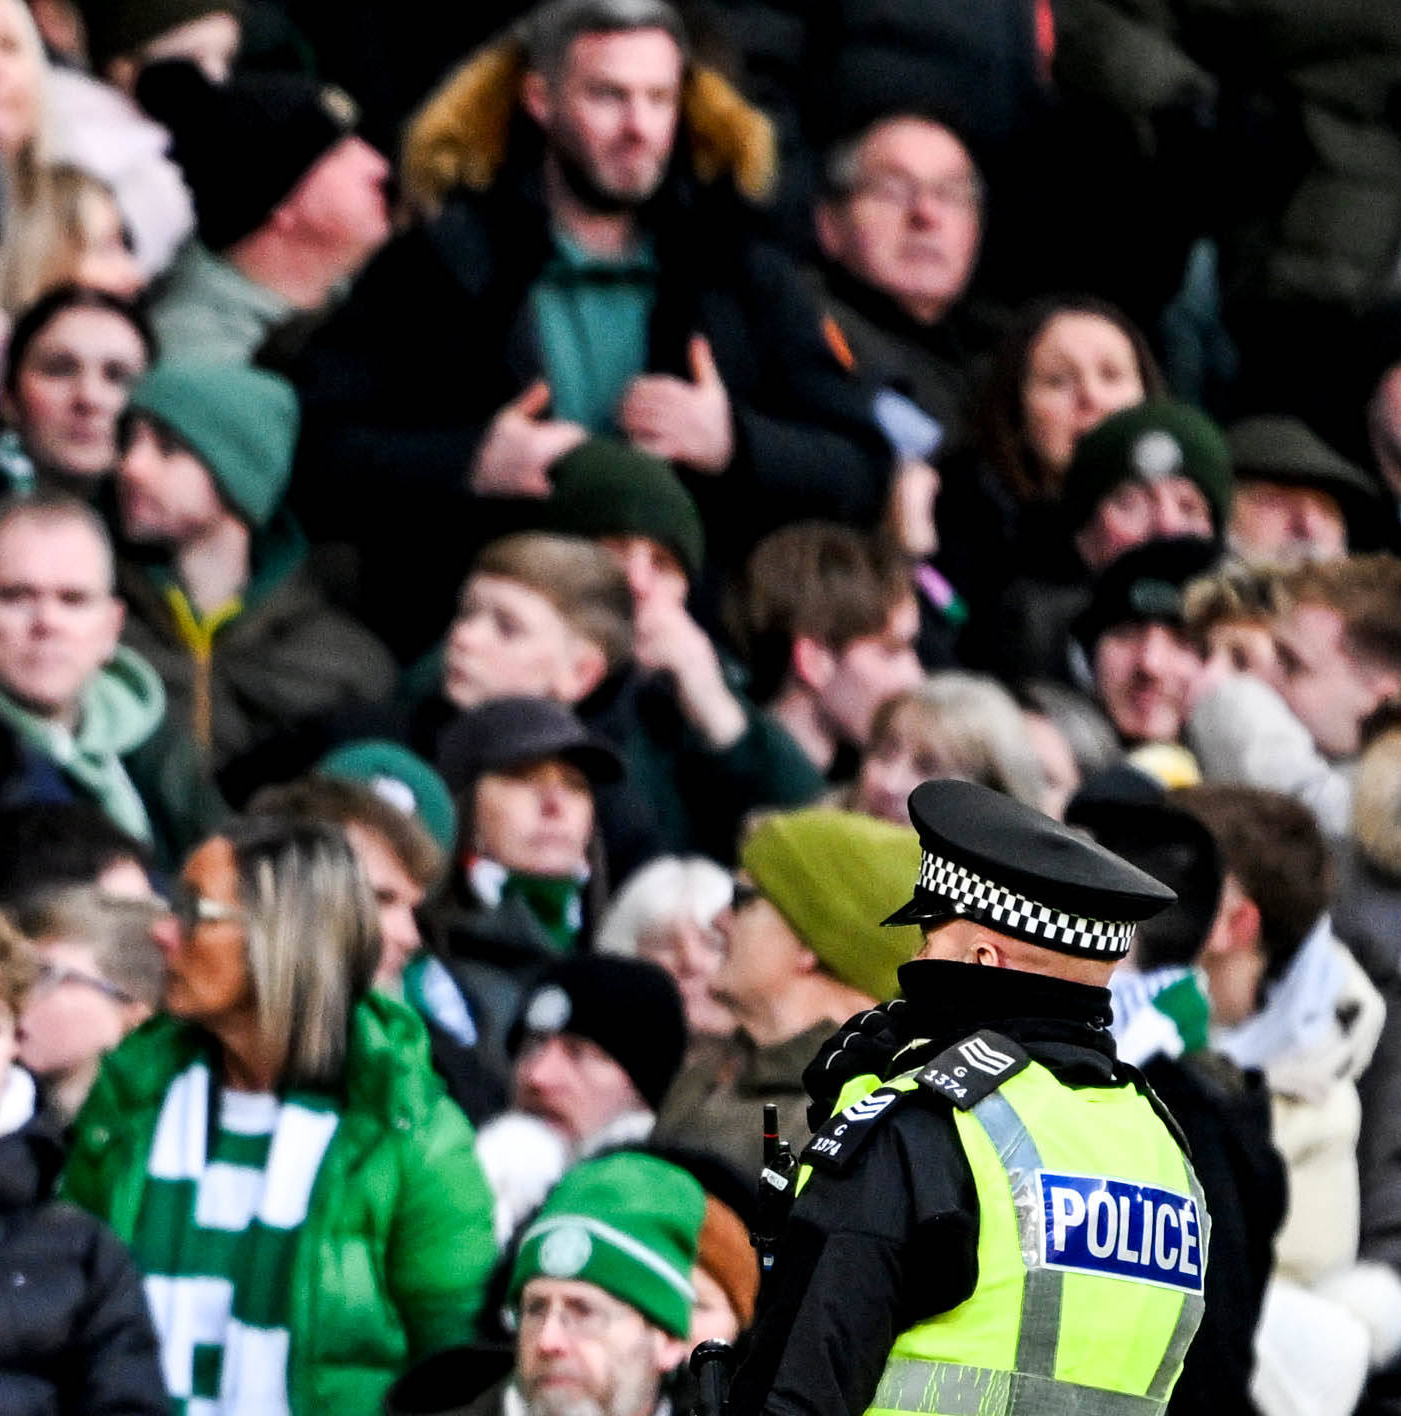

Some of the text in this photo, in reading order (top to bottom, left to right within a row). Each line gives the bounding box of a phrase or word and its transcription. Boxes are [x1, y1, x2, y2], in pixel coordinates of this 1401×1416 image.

[953, 1066, 968, 1078] G
[923, 1069, 968, 1098] 1374
[833, 1124, 848, 1137] G
[1050, 1186, 1199, 1276] POLICE
